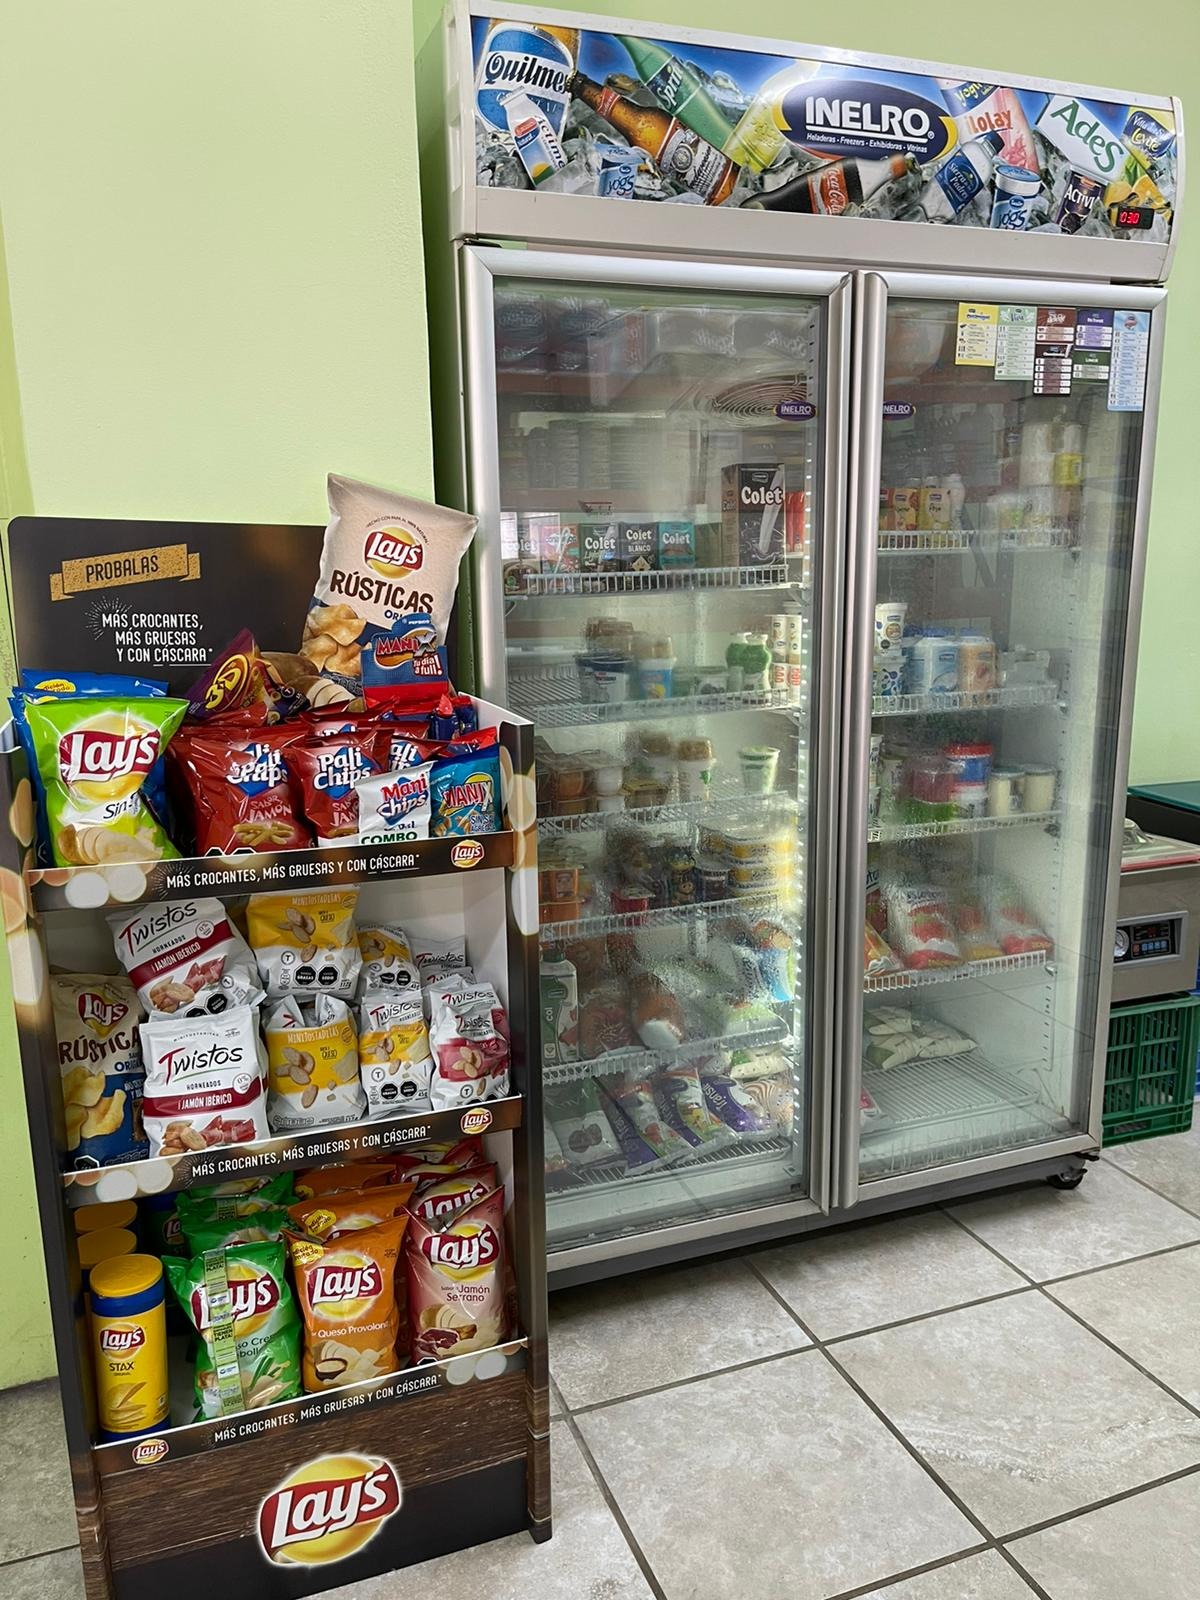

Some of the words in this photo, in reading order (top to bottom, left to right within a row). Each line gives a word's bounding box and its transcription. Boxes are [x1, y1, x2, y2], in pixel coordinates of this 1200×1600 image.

[484, 52, 569, 94] Quilme
[805, 96, 930, 138] INELRO
[807, 133, 836, 143] Heladeras
[840, 136, 865, 146] Freezers
[869, 139, 902, 150] Exhibidoras
[906, 143, 927, 153] Vitrinas
[1050, 100, 1124, 173] AdeS
[949, 162, 967, 183] Sierra
[781, 404, 811, 415] INELRO
[883, 404, 910, 414] NELRO
[741, 486, 783, 505] Colet
[512, 539, 538, 551] olet
[585, 537, 616, 550] Colet
[626, 529, 652, 541] Colet
[663, 532, 690, 545] Colet
[367, 532, 421, 567] Lay's
[86, 556, 159, 583] PROBALAS
[329, 569, 434, 614] RÚSTICAS
[102, 609, 128, 628] MÁS
[132, 613, 203, 630] CROCANTES,
[115, 627, 141, 645] MÁS
[144, 631, 196, 645] GRUESAS
[116, 648, 124, 662] Y
[127, 648, 150, 662] CON
[421, 653, 435, 665] día
[70, 732, 159, 783] Lay's
[318, 747, 363, 772] Pali
[314, 766, 371, 790] Chips
[380, 773, 428, 801] Mani
[242, 804, 292, 823] JAMÓN
[376, 794, 428, 817] Chips
[454, 845, 481, 861] Lay's
[166, 871, 190, 889] MÁS
[194, 869, 261, 886] CROCANTES,
[263, 863, 286, 880] MÁS
[289, 861, 334, 878] GRUESAS
[337, 861, 344, 873] Y
[347, 858, 367, 872] CON
[118, 902, 197, 957] Twistos
[370, 1002, 421, 1028] Twistos
[59, 1025, 141, 1065] RÚSTICA
[158, 1043, 243, 1086] Twistos
[186, 1079, 222, 1091] HORNEADOS
[181, 1097, 205, 1110] JAMÓN
[205, 1093, 232, 1107] IBÉRICO
[463, 1112, 490, 1129] Lay's
[192, 1160, 215, 1177] MÁS
[218, 1153, 281, 1173] CROCANTES,
[283, 1145, 304, 1161] MÁS
[307, 1138, 351, 1157] GRUESAS
[353, 1138, 359, 1149] Y
[362, 1134, 381, 1147] CON
[430, 1231, 494, 1269] Lay's
[313, 1267, 377, 1304] Lay's
[459, 1284, 490, 1294] Jamón
[200, 1280, 272, 1330] Ly's
[447, 1293, 485, 1302] Serrano
[103, 1330, 142, 1350] Lay's
[318, 1328, 347, 1338] Queso
[109, 1361, 135, 1372] STAX
[214, 1427, 236, 1443] MÁS
[239, 1413, 299, 1436] CROCANTES,
[300, 1404, 321, 1420] MÁS
[324, 1393, 365, 1413] GRUESAS
[367, 1392, 373, 1402] Y
[376, 1386, 394, 1399] CON
[136, 1442, 165, 1460] Lay's
[271, 1472, 390, 1549] Lay's
